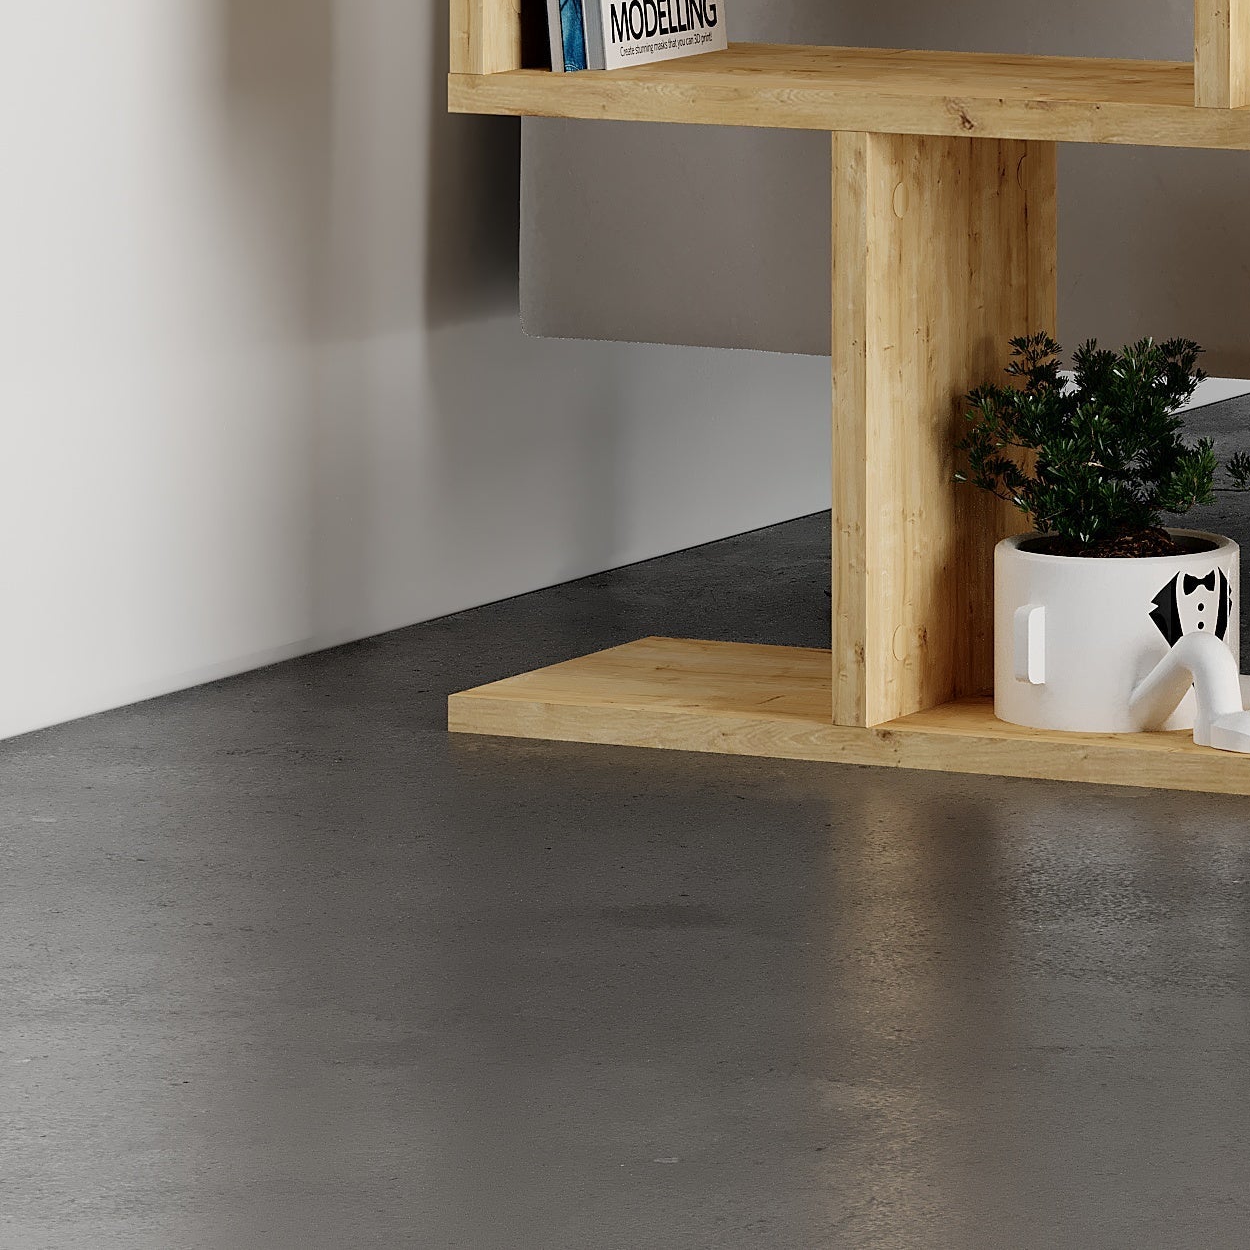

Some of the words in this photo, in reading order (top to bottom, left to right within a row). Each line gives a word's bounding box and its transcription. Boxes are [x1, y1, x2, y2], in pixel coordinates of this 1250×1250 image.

[620, 46, 634, 57] Create
[635, 43, 653, 54] stunning
[654, 40, 667, 51] masks
[668, 38, 677, 48] that
[694, 33, 700, 44] 3D
